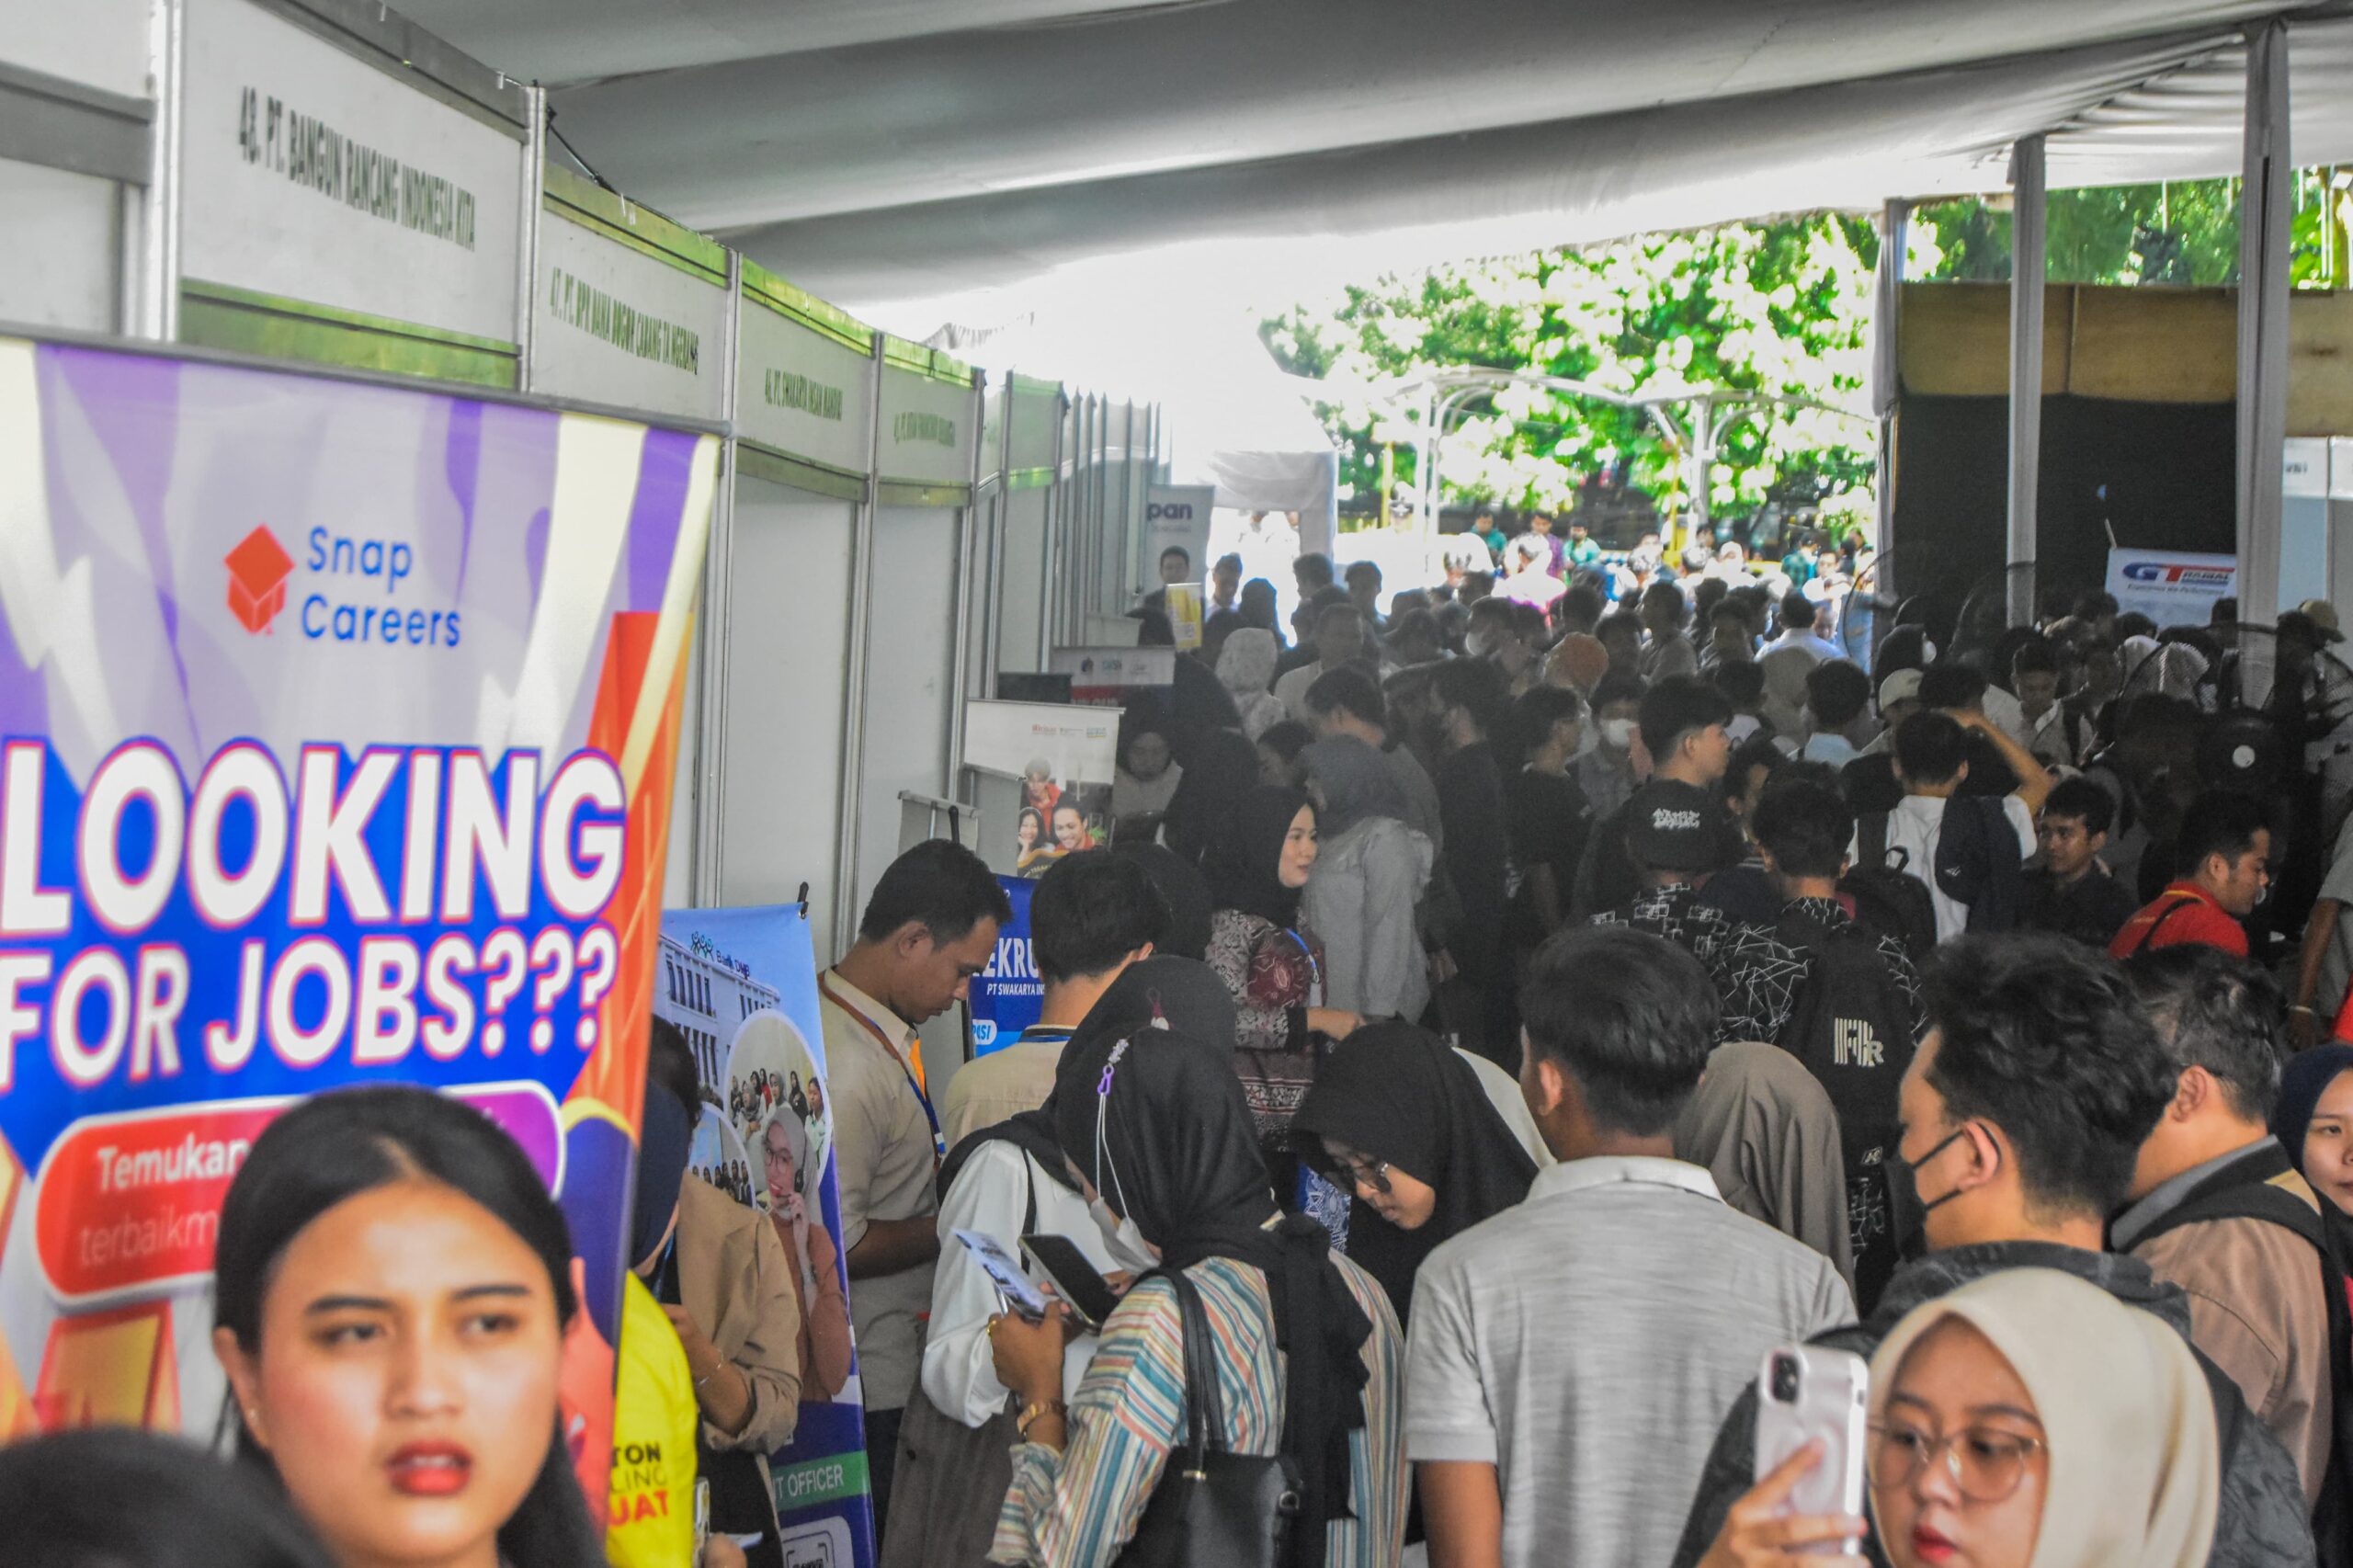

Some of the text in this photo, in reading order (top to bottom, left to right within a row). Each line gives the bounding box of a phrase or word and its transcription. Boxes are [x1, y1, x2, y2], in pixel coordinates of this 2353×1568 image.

[289, 108, 344, 202] BANGUN
[307, 526, 413, 594] Snap
[301, 594, 461, 647] Careers
[2, 743, 625, 932] LOOKING
[0, 945, 187, 1087] FOR
[208, 927, 618, 1068] JOBS???
[986, 983, 997, 995] PT
[998, 983, 1035, 995] SWAKARYA
[787, 1464, 844, 1497] OFFICER
